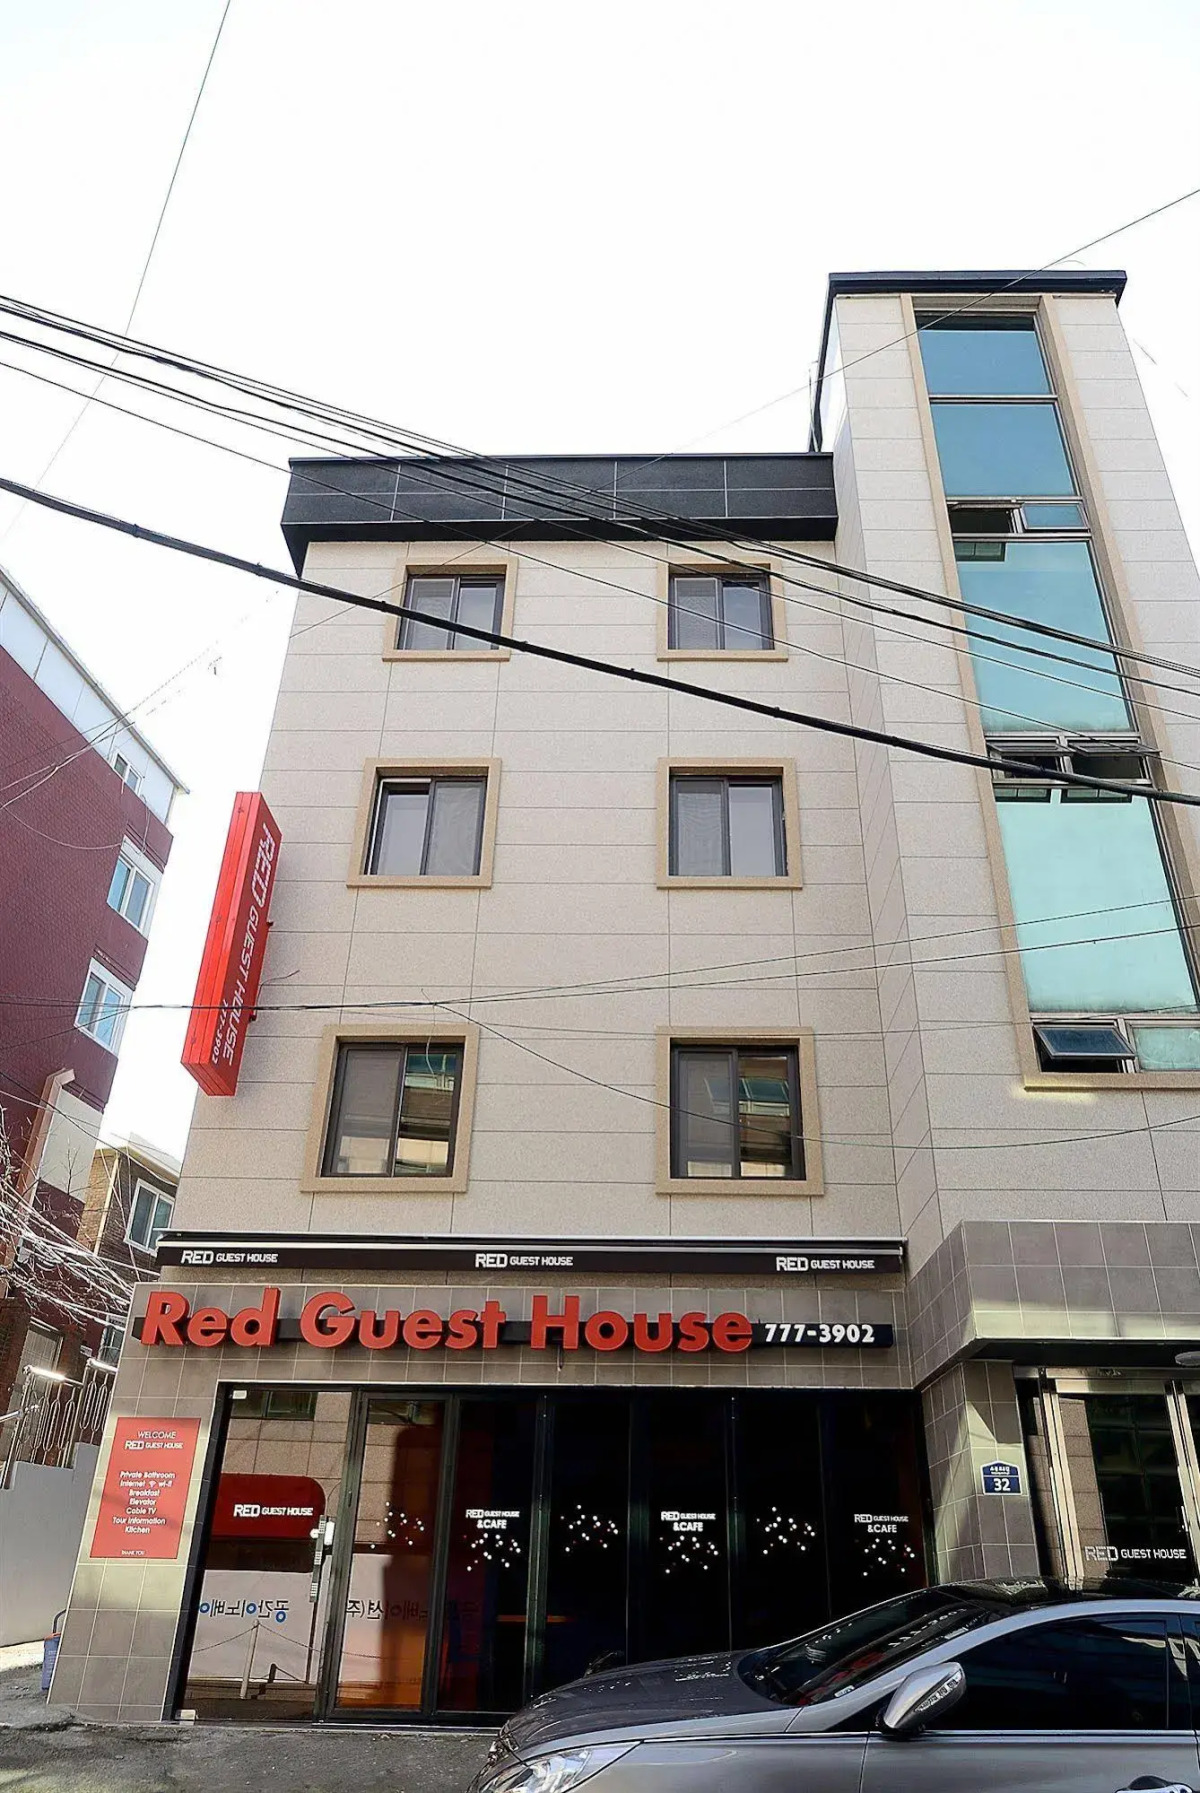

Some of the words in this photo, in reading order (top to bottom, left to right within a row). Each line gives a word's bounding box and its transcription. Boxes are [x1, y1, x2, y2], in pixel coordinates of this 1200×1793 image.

[251, 823, 275, 908] RED
[240, 905, 259, 983] GUEST
[222, 982, 246, 1066] HOUSE
[181, 1250, 214, 1264] RED
[215, 1253, 245, 1263] GUEST
[246, 1253, 278, 1263] HOUSE
[475, 1253, 508, 1268] RED
[509, 1256, 540, 1266] GUEST
[541, 1256, 573, 1266] HOUSE
[776, 1257, 808, 1271] RED
[810, 1260, 841, 1269] GUEST
[842, 1260, 875, 1269] HOUSE
[141, 1286, 281, 1347] Red
[300, 1291, 506, 1350] Guest
[530, 1295, 752, 1352] House
[765, 1324, 875, 1343] 777-3902
[138, 1431, 177, 1439] WELCOME
[125, 1440, 145, 1450] RED
[143, 1471, 176, 1479] Bathroom
[994, 1478, 1010, 1491] 32
[129, 1489, 160, 1497] Breakfast
[126, 1507, 147, 1515] Cable
[233, 1504, 261, 1517] RED
[261, 1507, 287, 1515] GUEST
[286, 1507, 314, 1516] HOUSE
[465, 1509, 484, 1518] RED
[661, 1511, 680, 1521] RED
[854, 1514, 873, 1523] RED
[125, 1526, 151, 1534] Kitchen
[1084, 1546, 1119, 1561] RED
[1120, 1549, 1151, 1559] GUEST
[1153, 1549, 1187, 1559] HOUSE
